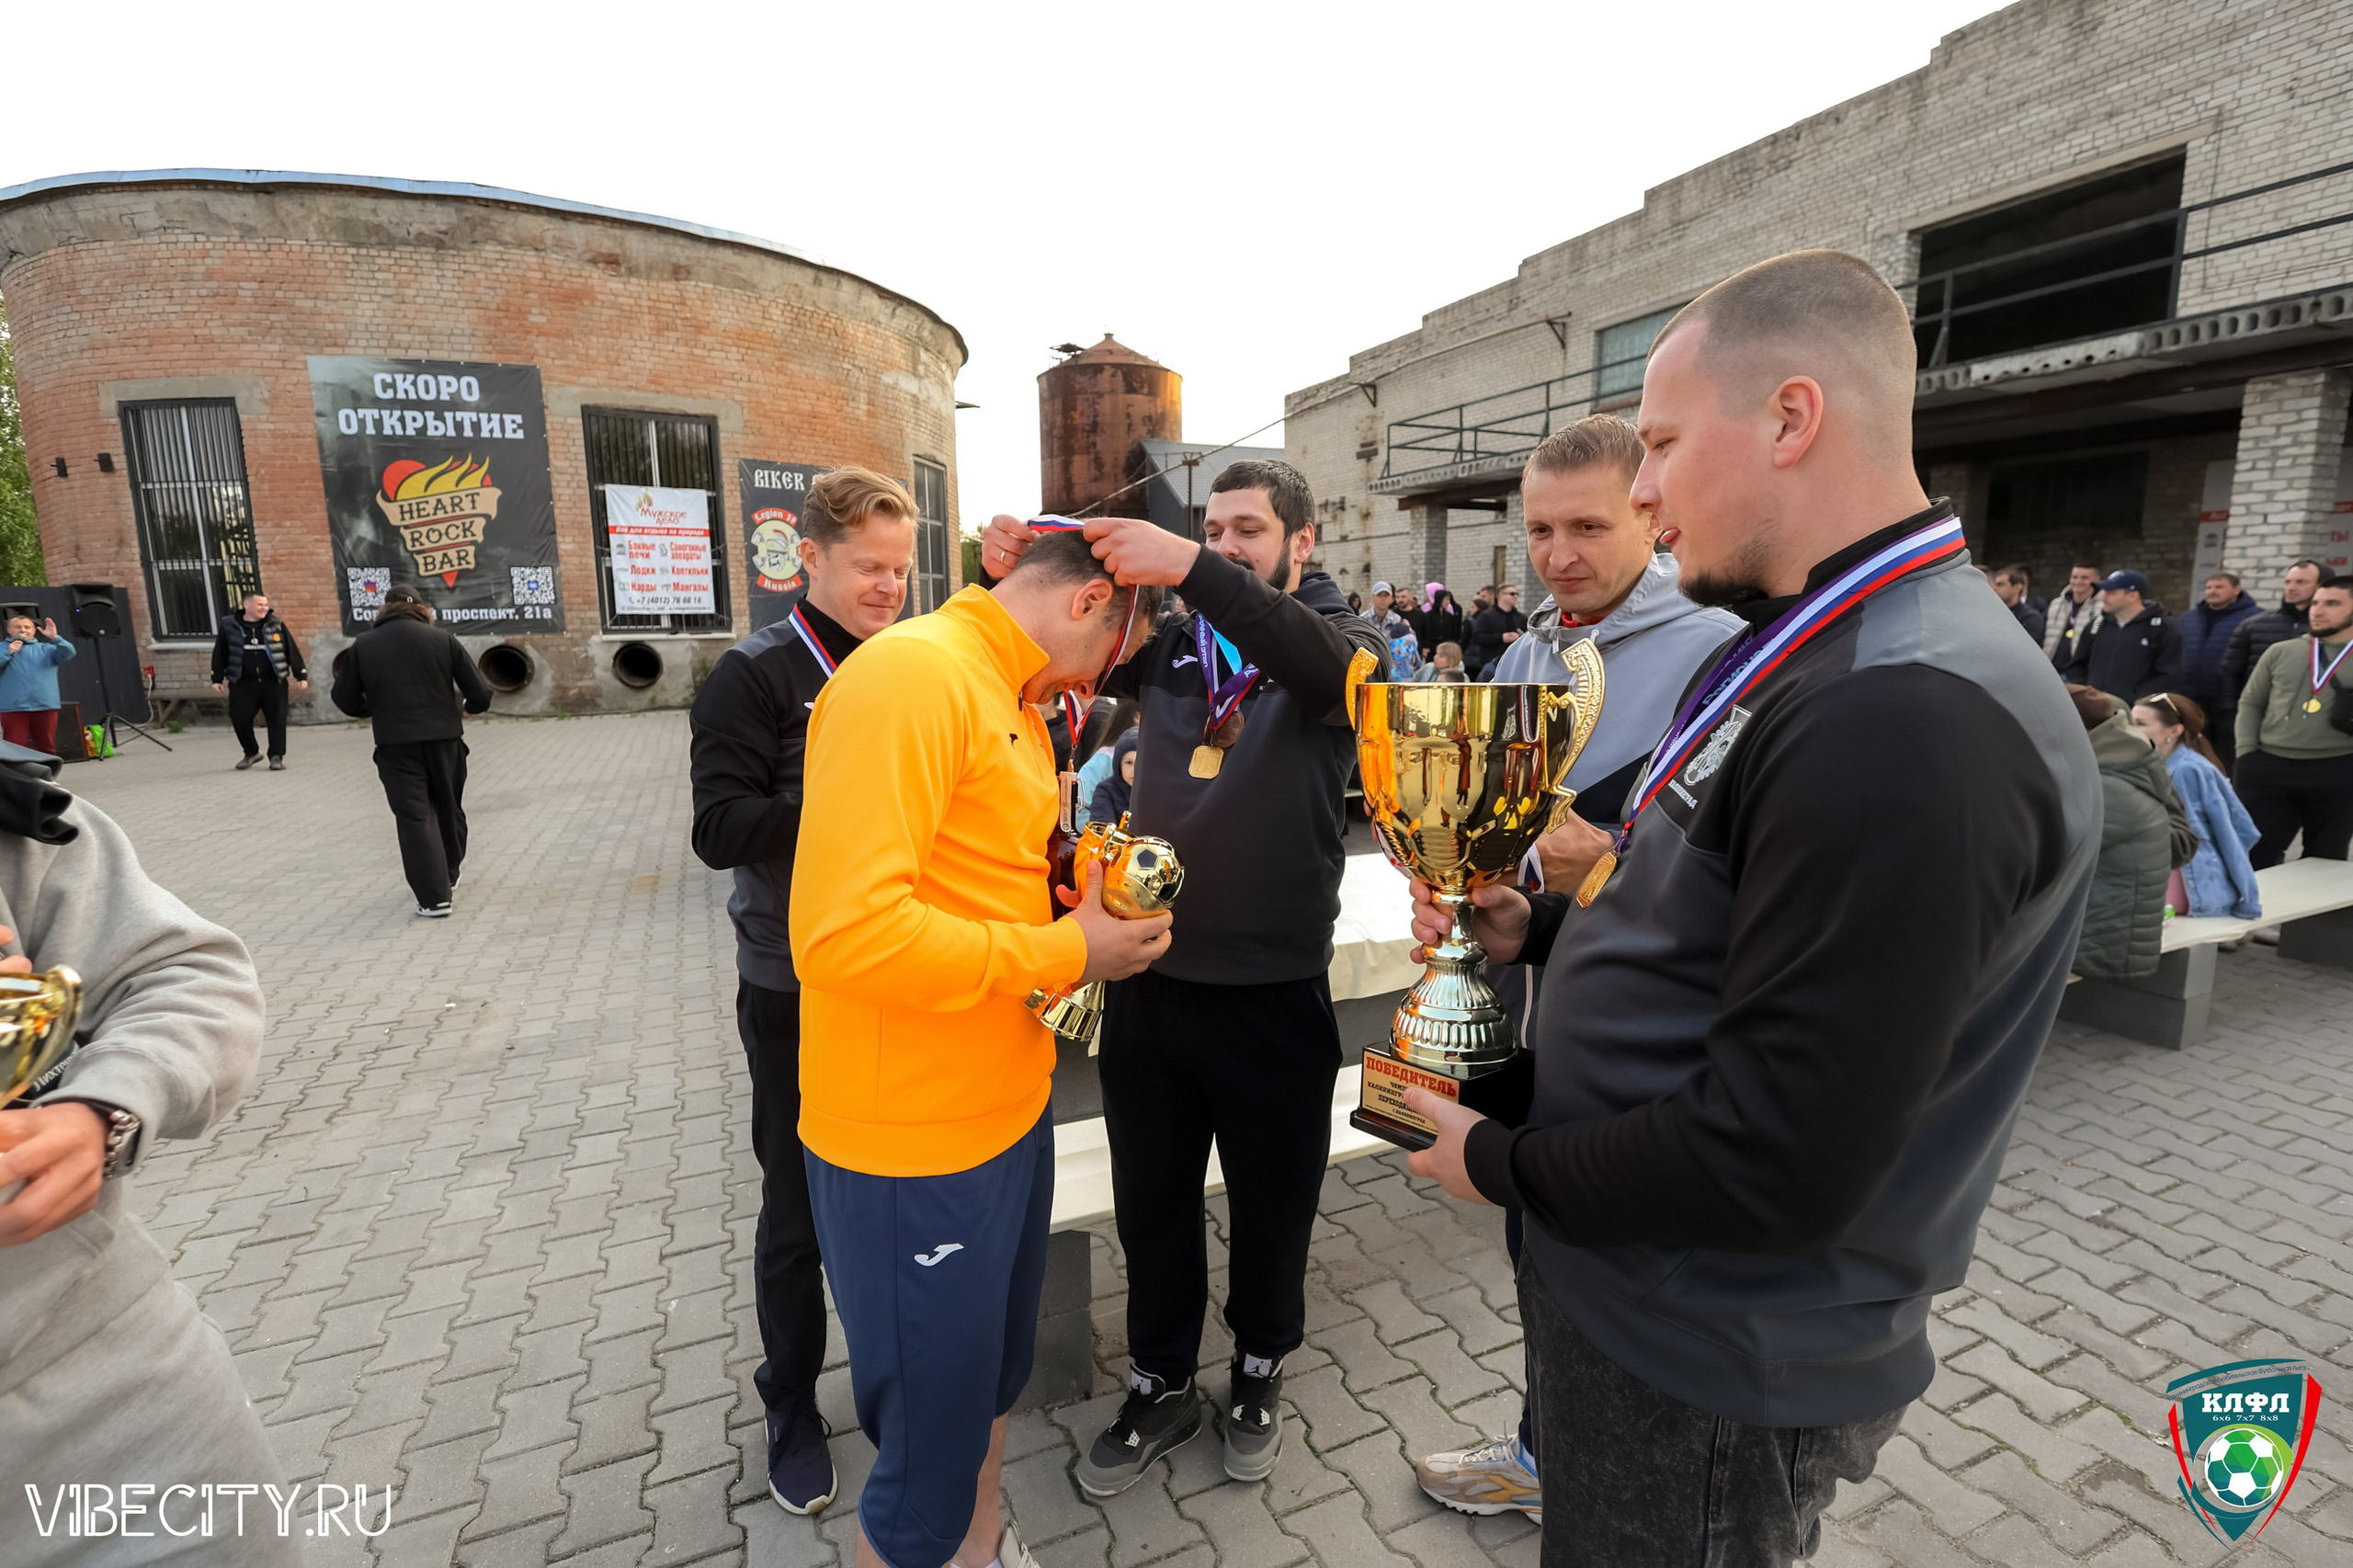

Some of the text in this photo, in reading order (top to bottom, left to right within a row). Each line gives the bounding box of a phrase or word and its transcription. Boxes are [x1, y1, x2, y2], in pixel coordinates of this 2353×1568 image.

[373, 372, 479, 402] СКОРО
[337, 408, 524, 439] ОТКРЫТИЕ
[754, 469, 805, 491] BIKER
[399, 493, 480, 521] HEART
[754, 508, 784, 521] Legion
[410, 520, 477, 548] ROCK
[628, 540, 655, 551] Банные
[669, 541, 706, 552] Самогонные
[629, 551, 650, 559] печи
[671, 551, 701, 561] аппараты
[422, 551, 472, 574] BAR
[631, 564, 655, 575] Лодки
[671, 565, 709, 575] Коптильни
[631, 582, 656, 592] Нарды
[673, 582, 709, 592] Мангалы
[764, 578, 796, 591] Russia
[647, 597, 670, 605] (4012)
[441, 608, 519, 623] проспект,
[524, 607, 551, 619] 21а
[1366, 1056, 1456, 1096] ПОБЕДИТЕЛЬ
[1368, 1081, 1404, 1098] КАЛИНИНГР
